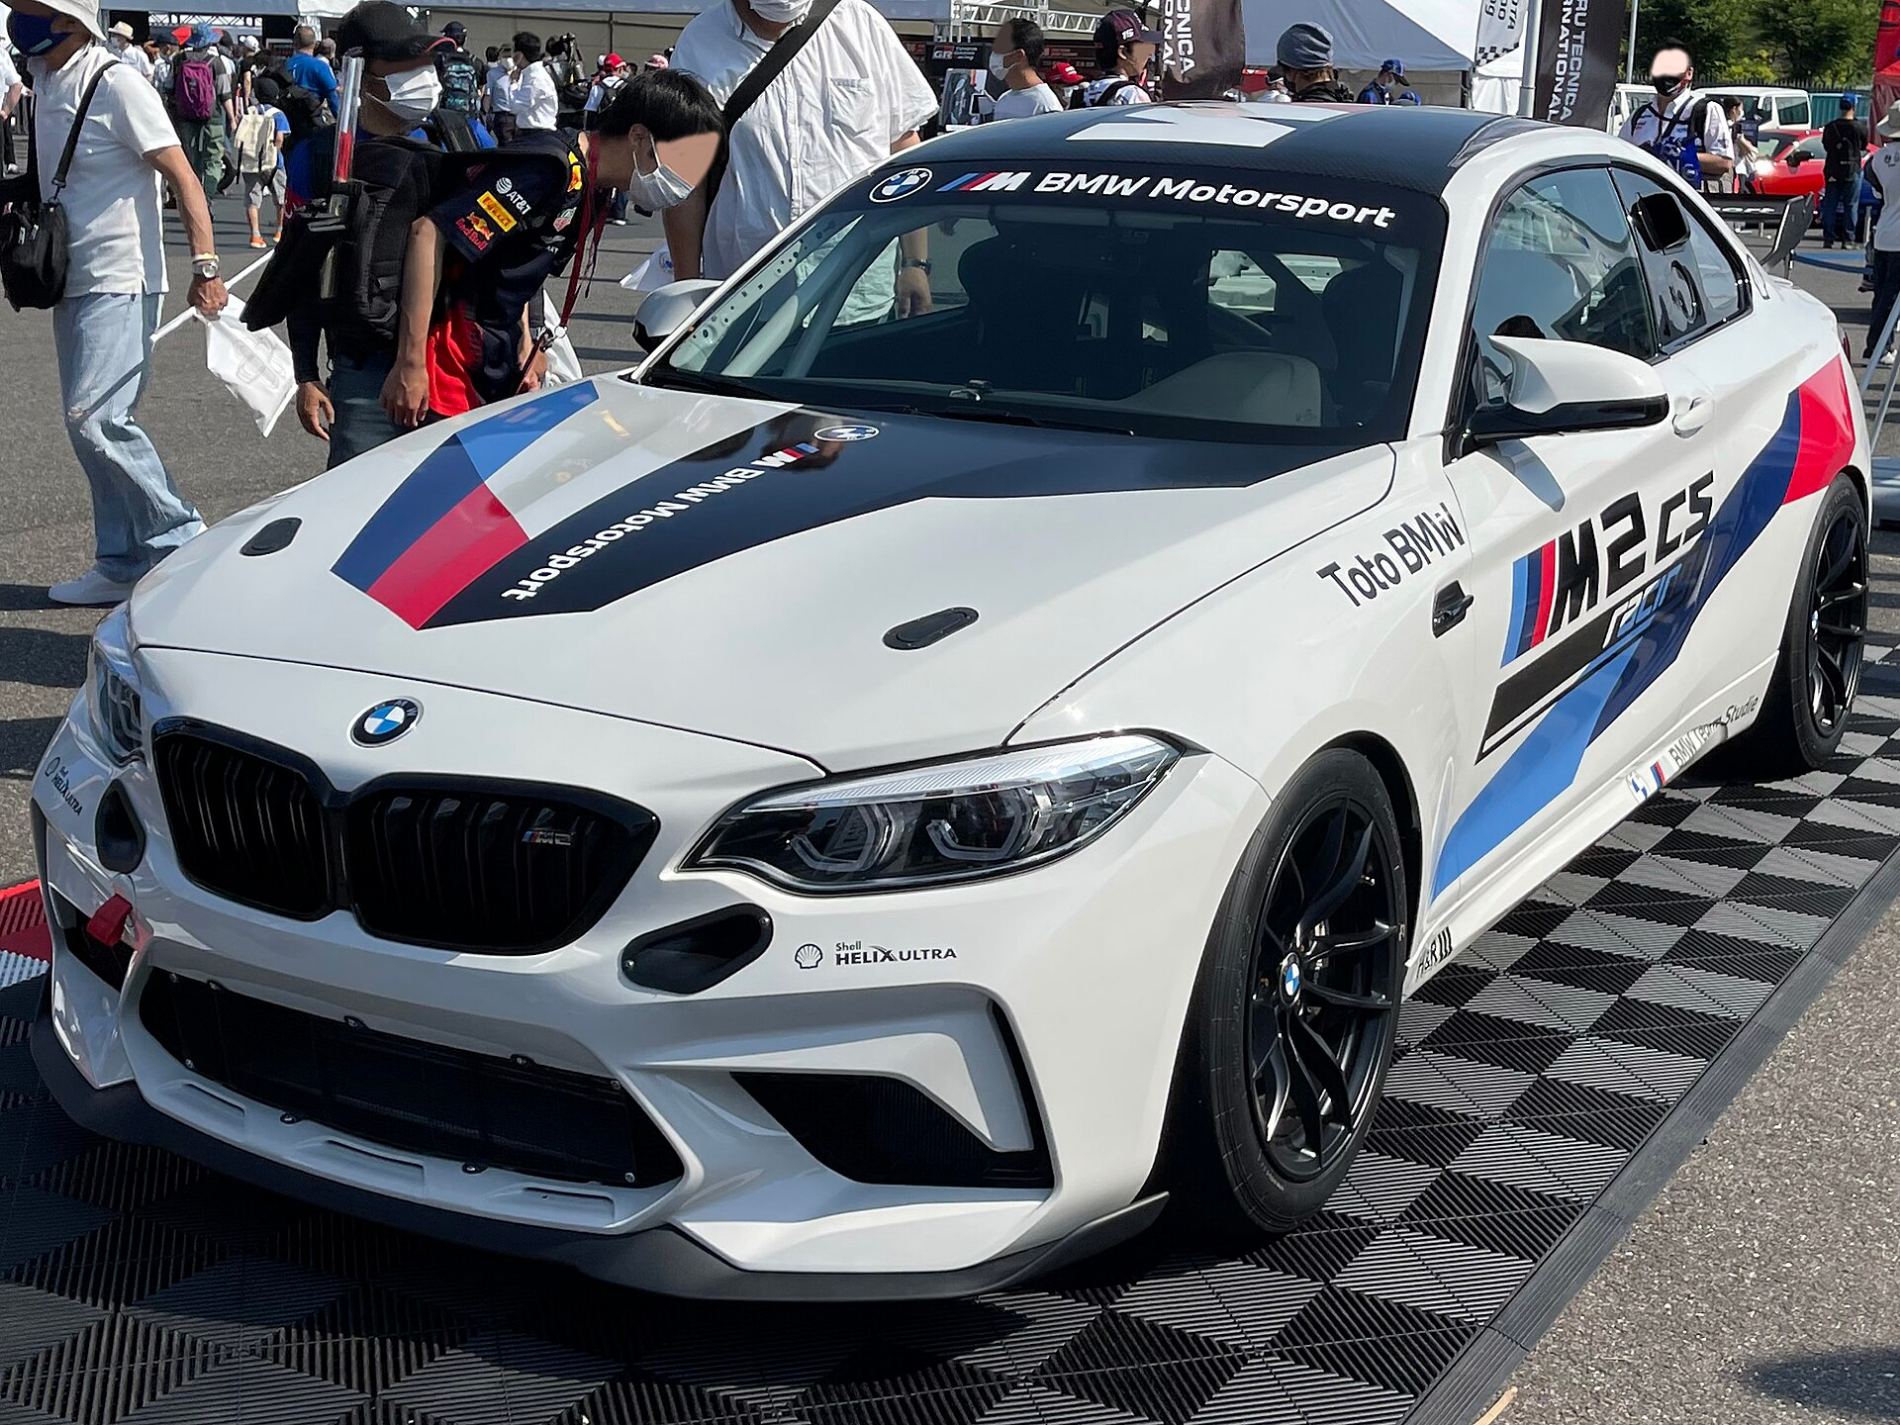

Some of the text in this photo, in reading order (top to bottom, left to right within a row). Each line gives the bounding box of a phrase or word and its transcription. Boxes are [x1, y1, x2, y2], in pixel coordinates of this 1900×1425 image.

[1560, 30, 1586, 121] TECNICA
[506, 191, 532, 215] AT&T
[1034, 172, 1151, 196] BMW
[1148, 176, 1396, 229] Motorsport
[675, 468, 765, 503] BMW
[1654, 470, 1714, 563] CS
[501, 501, 690, 600] Motorsport
[1316, 502, 1465, 607] Toto BMW
[835, 941, 862, 951] Shell
[835, 945, 957, 966] HELIX ULTRA
